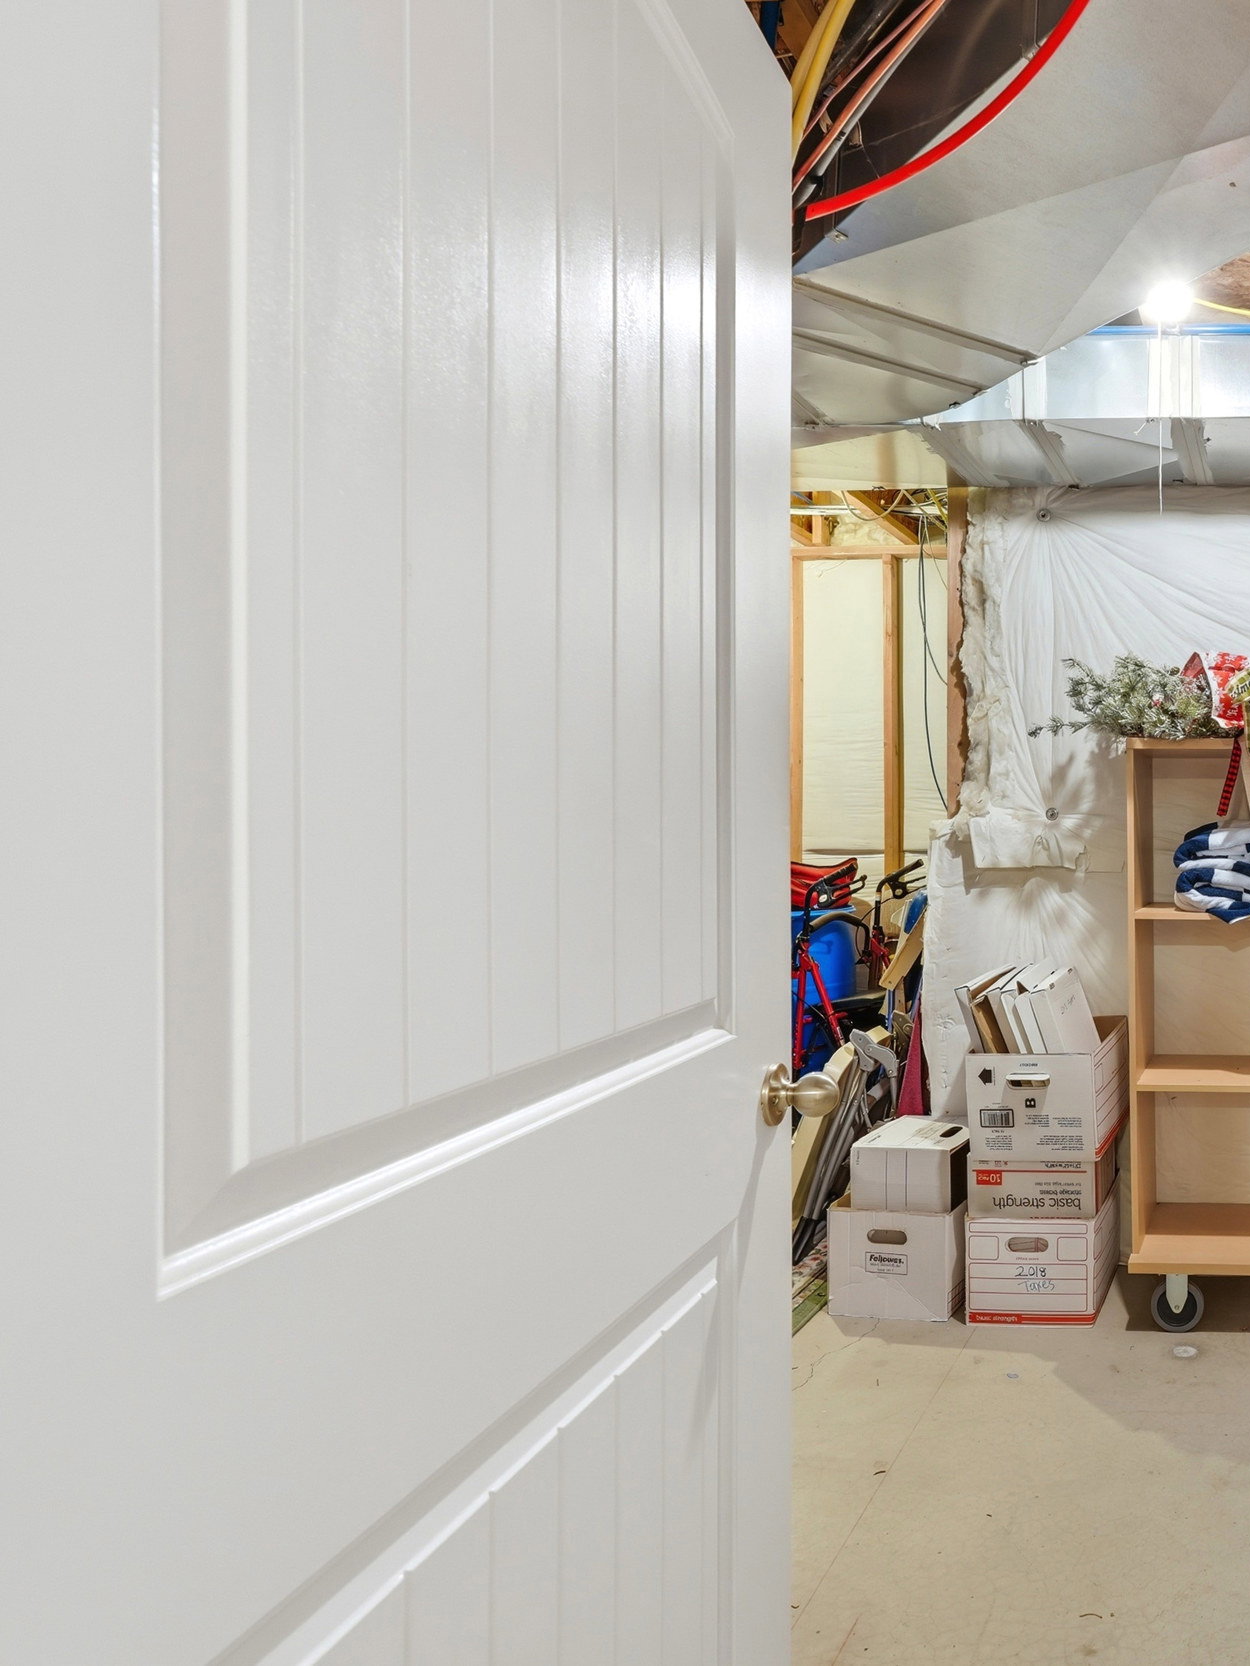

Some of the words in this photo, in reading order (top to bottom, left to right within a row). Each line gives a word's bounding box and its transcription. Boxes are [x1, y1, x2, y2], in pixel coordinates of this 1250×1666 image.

[1025, 1098, 1036, 1108] B
[989, 1174, 1001, 1183] 10
[1059, 1188, 1082, 1196] storage
[992, 1194, 1045, 1210] strength
[1048, 1197, 1081, 1210] basic
[1014, 1266, 1047, 1278] 2018
[1017, 1279, 1056, 1293] Taxes
